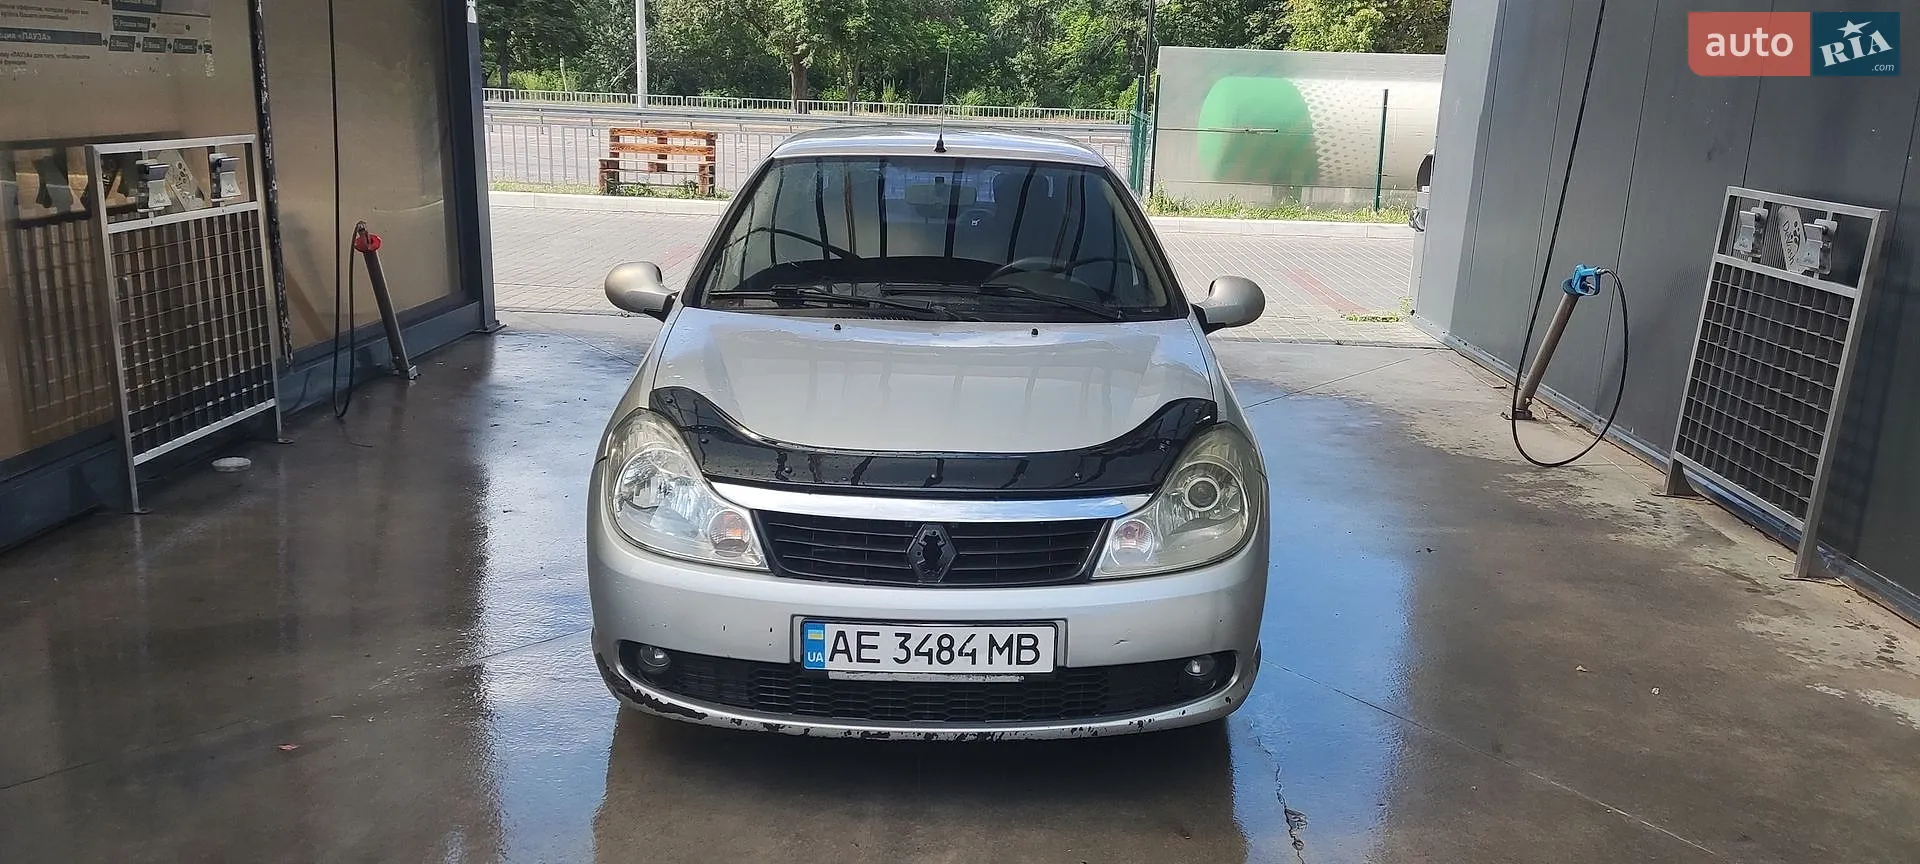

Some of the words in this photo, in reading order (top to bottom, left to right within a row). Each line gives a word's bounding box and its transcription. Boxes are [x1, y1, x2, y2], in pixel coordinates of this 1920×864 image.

[807, 651, 824, 663] UA
[828, 630, 881, 664] AE
[892, 632, 977, 666] 3484
[987, 633, 1041, 666] MB
